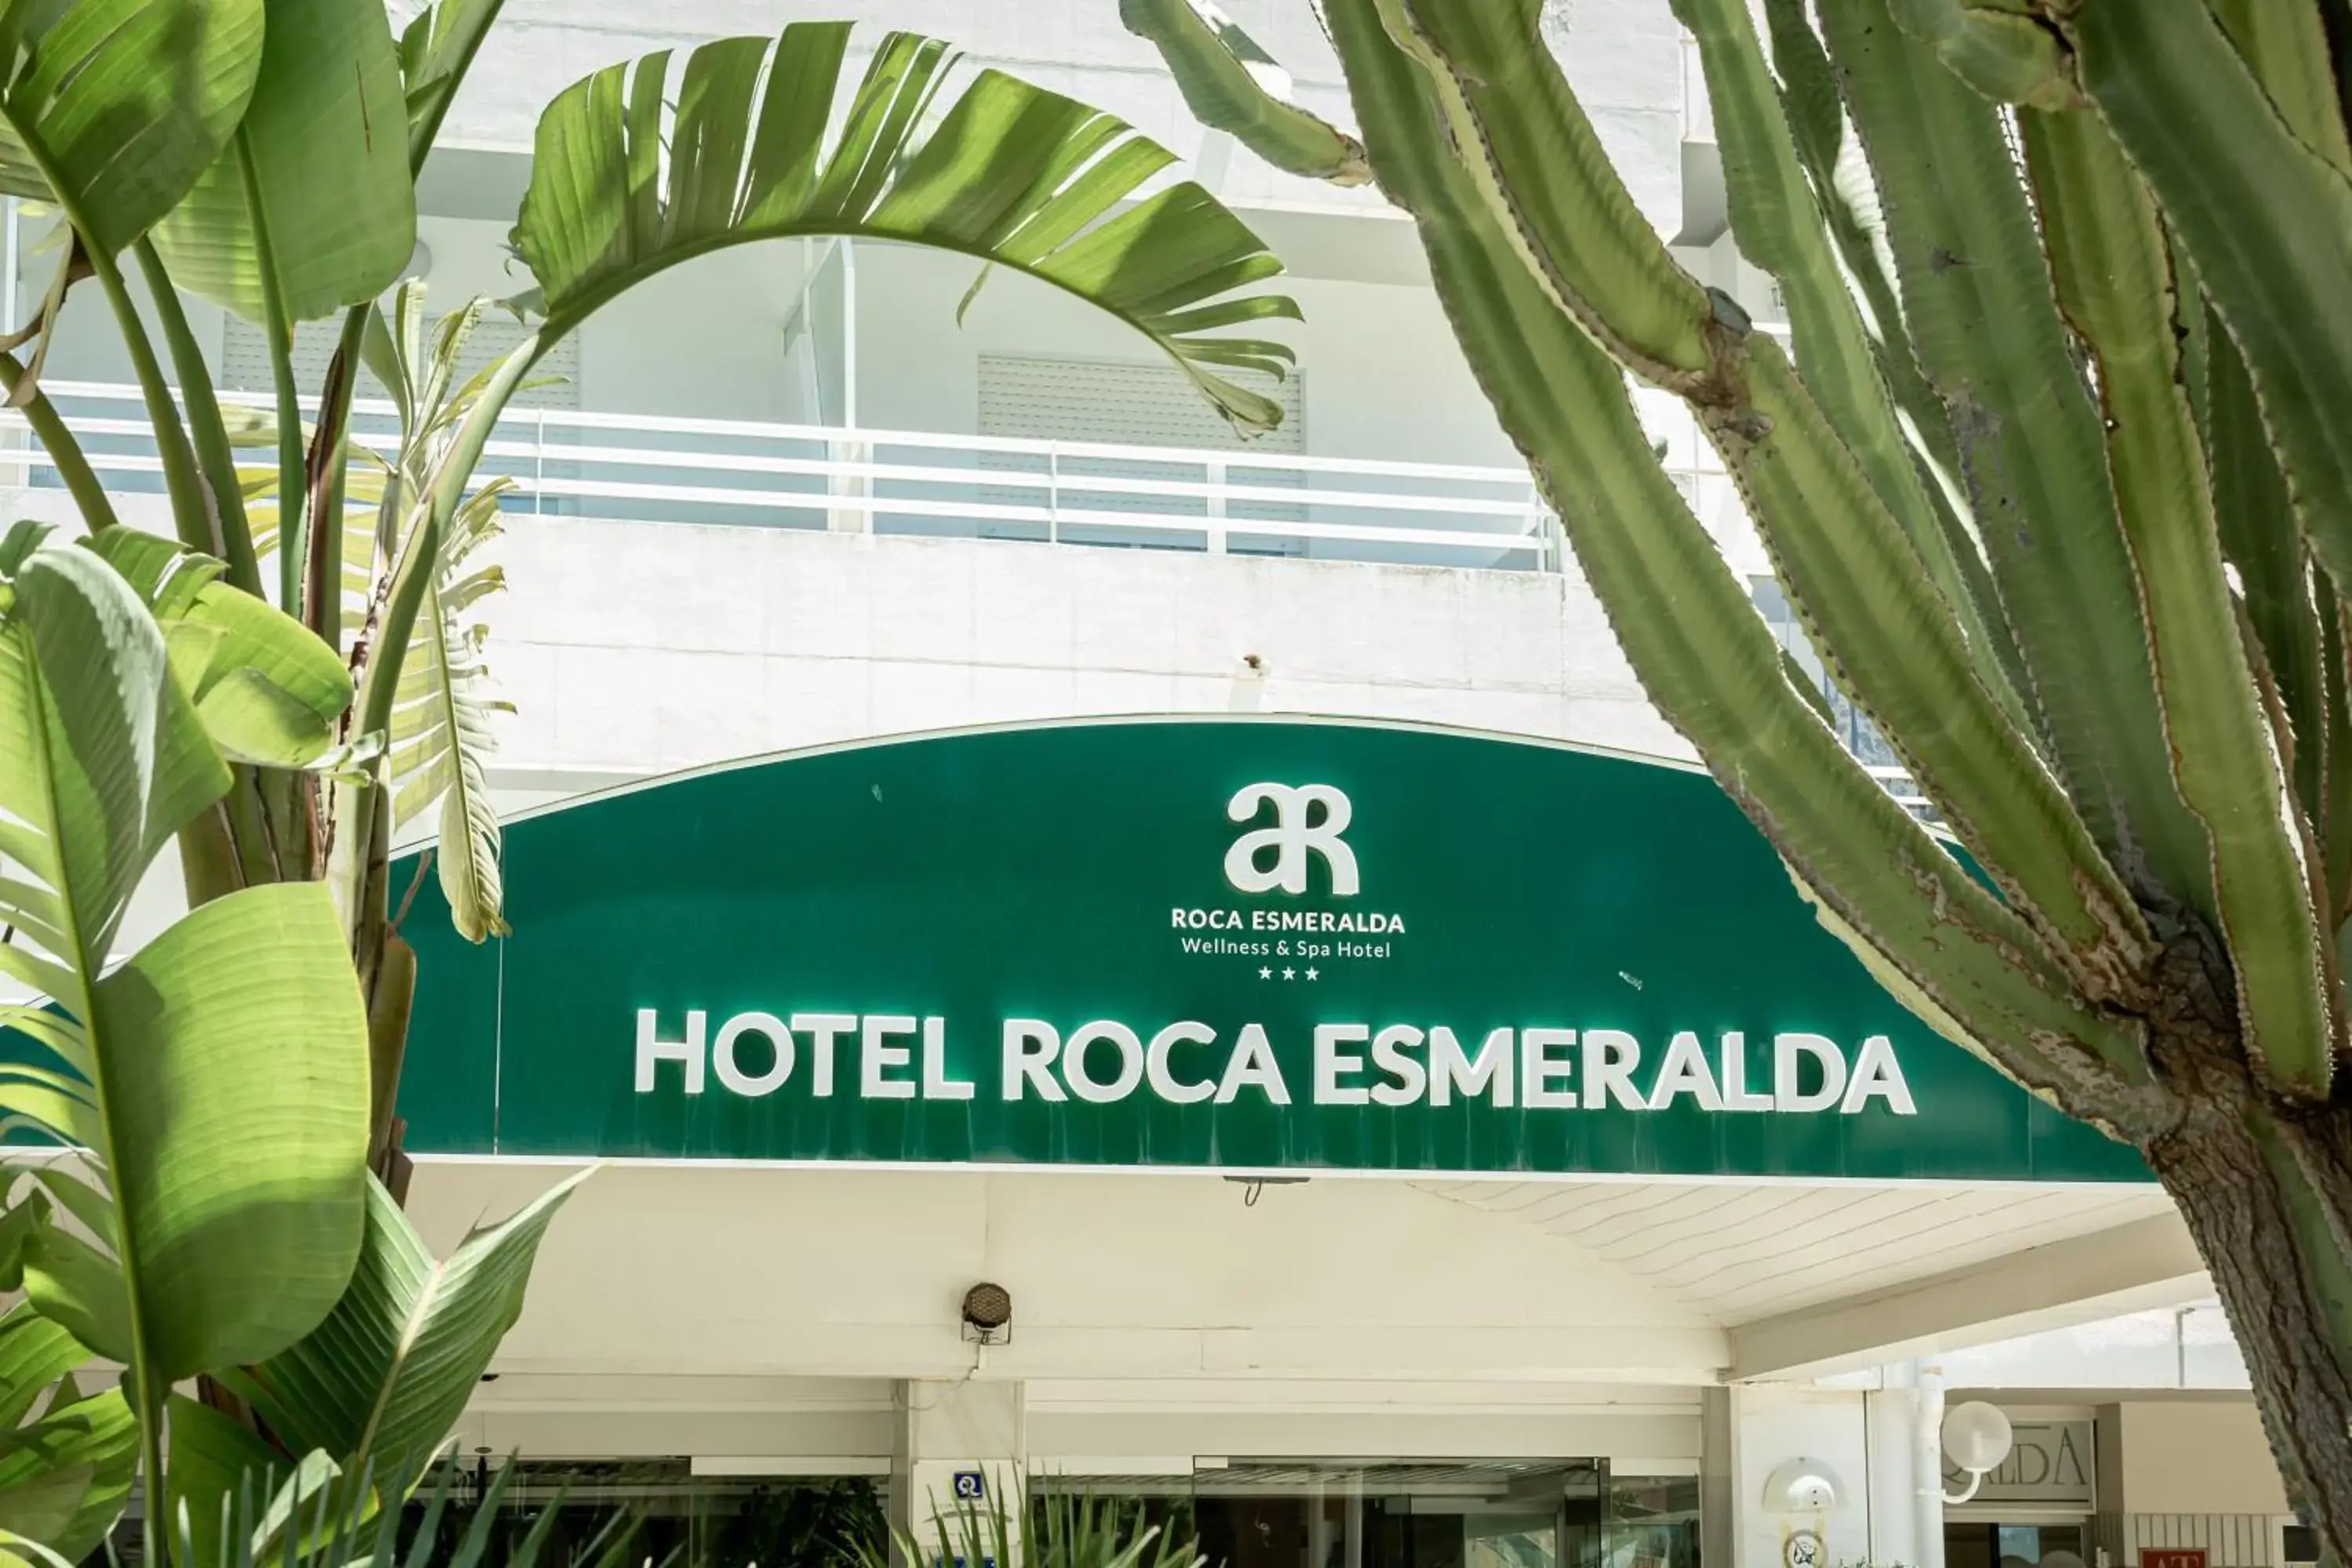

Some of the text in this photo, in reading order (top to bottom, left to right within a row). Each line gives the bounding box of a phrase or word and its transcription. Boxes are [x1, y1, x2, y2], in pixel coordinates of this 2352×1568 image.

[1171, 908, 1406, 934] ROCA ESMERALDA
[1181, 938, 1390, 959] Wellness & Spa Hotel
[635, 1008, 1918, 1116] HOTEL ROCA ESMERALDA
